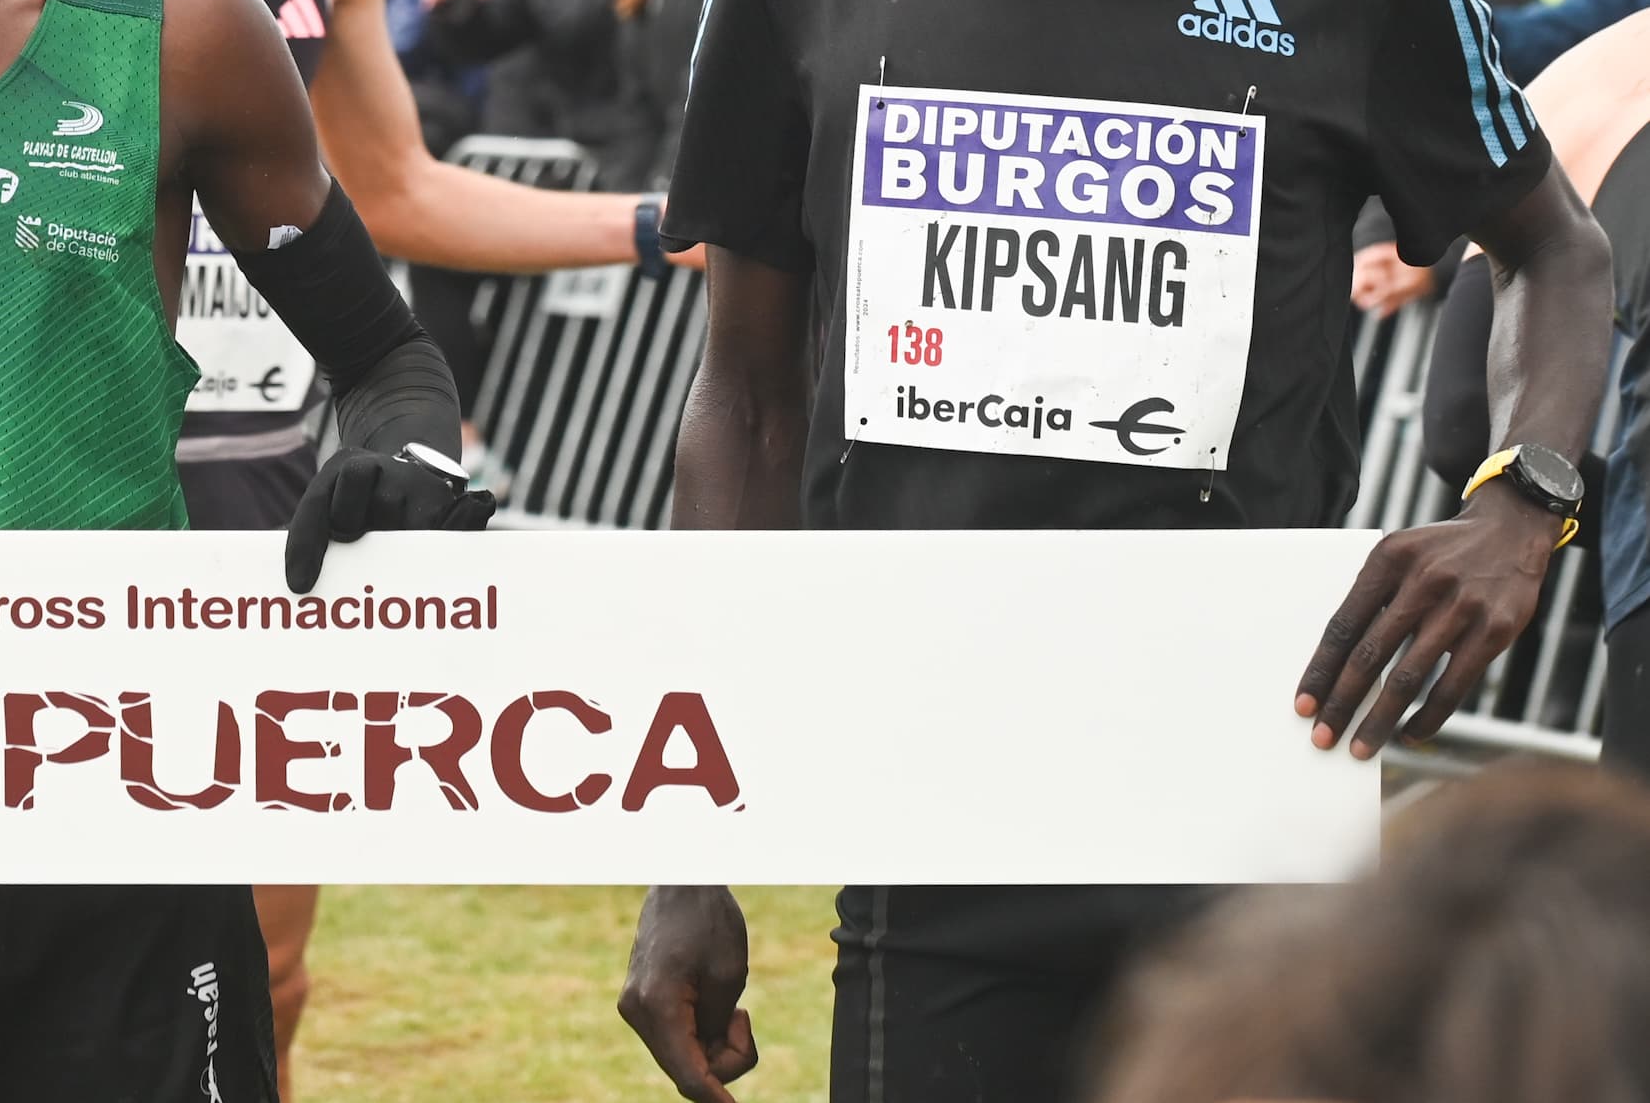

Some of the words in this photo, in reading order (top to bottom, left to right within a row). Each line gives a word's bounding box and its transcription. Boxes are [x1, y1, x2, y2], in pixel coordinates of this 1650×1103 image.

[1177, 12, 1296, 57] adidas
[22, 141, 55, 157] PLAYAS
[56, 143, 69, 158] DE
[882, 103, 1238, 170] DIPUTACIÓN
[58, 169, 79, 178] club
[880, 147, 1235, 226] BURGOS
[46, 237, 66, 252] de
[68, 240, 120, 263] Castelló
[47, 223, 117, 247] Diputació
[921, 222, 1188, 328] KIPSANG
[887, 324, 943, 367] 138
[895, 386, 1073, 439] iberCaja
[127, 584, 498, 630] Internacional
